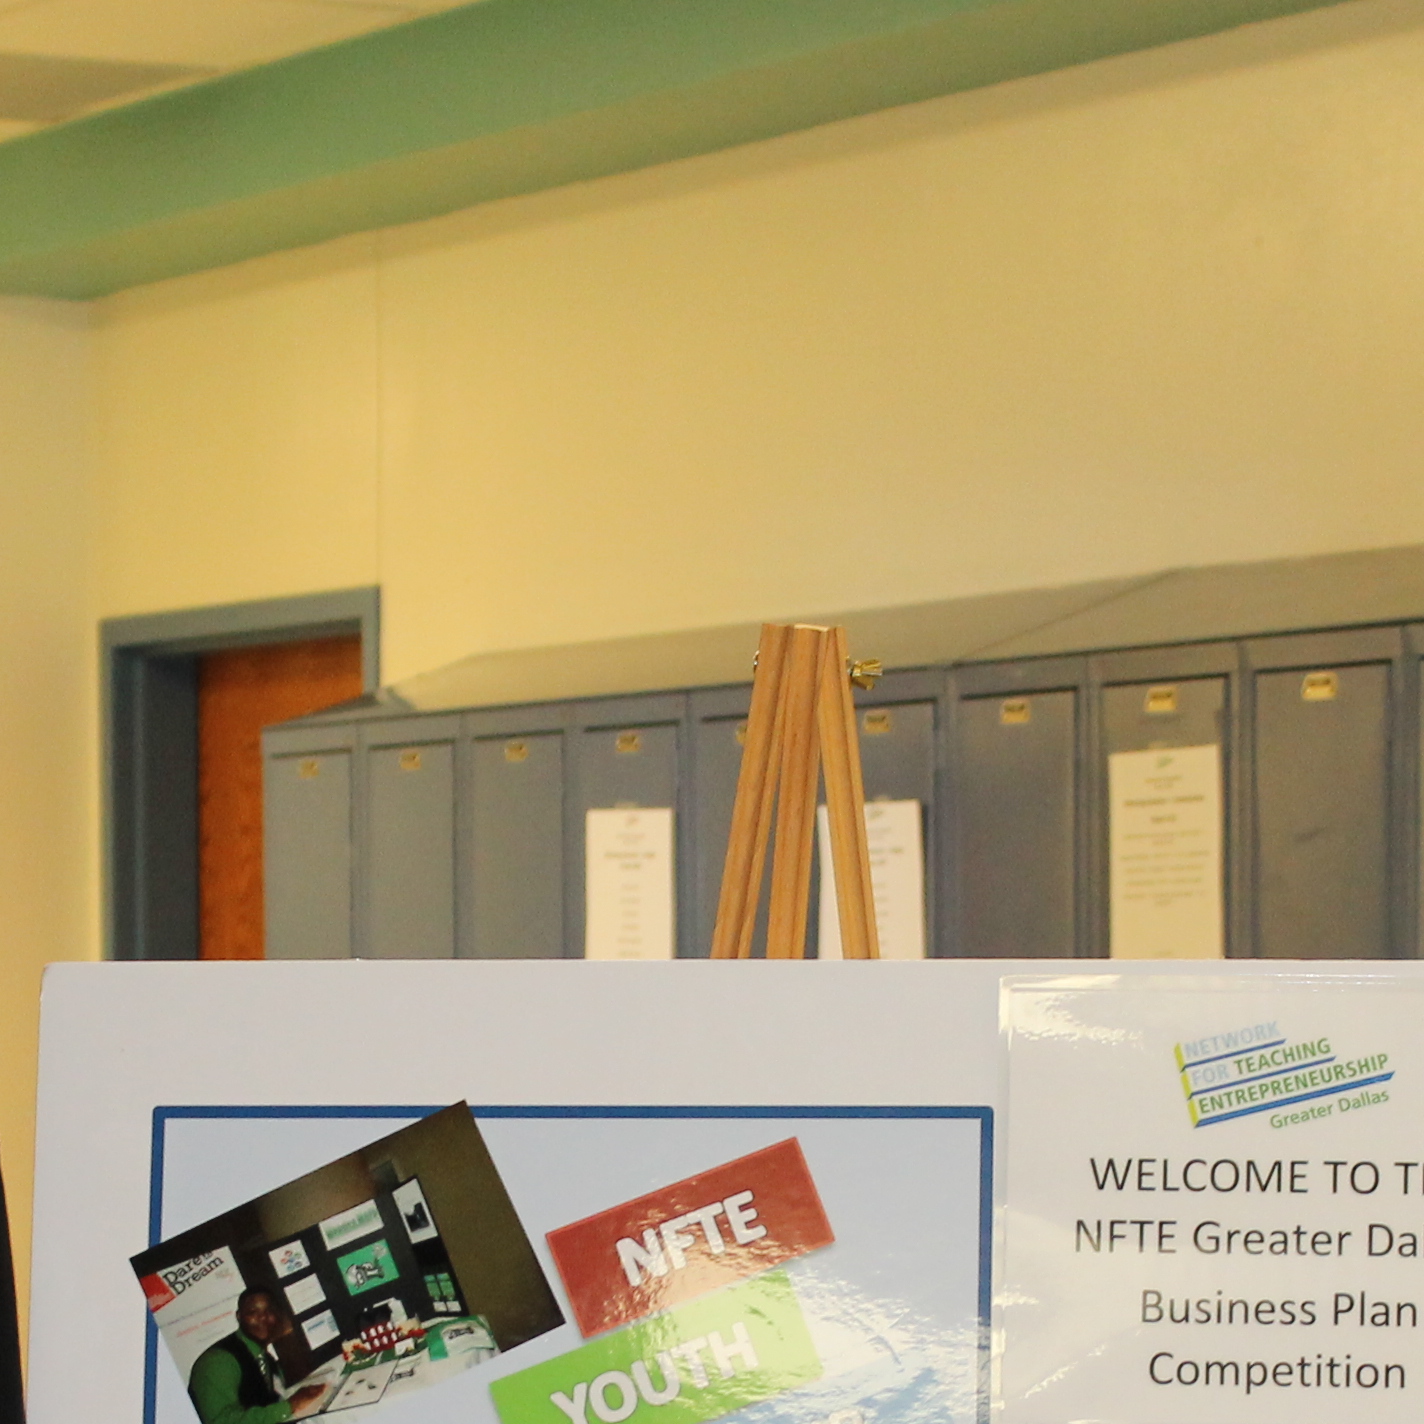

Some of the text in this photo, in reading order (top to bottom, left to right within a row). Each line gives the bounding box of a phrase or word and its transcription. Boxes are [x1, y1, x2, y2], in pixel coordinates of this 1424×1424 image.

[1185, 1021, 1280, 1057] NETWORK
[1192, 1038, 1331, 1086] FOR TEACHING
[1198, 1053, 1388, 1114] ENTREPRENEURSHIP
[1270, 1090, 1390, 1129] Greater Dallas
[1090, 1158, 1309, 1194] WELCOME
[1325, 1162, 1380, 1195] TO
[615, 1190, 767, 1288] NFTE
[1075, 1220, 1177, 1254] NFTE
[1194, 1221, 1352, 1256] Greater
[172, 1257, 224, 1295] Dream
[1141, 1290, 1417, 1328] Business Plan
[1149, 1353, 1405, 1394] Competition
